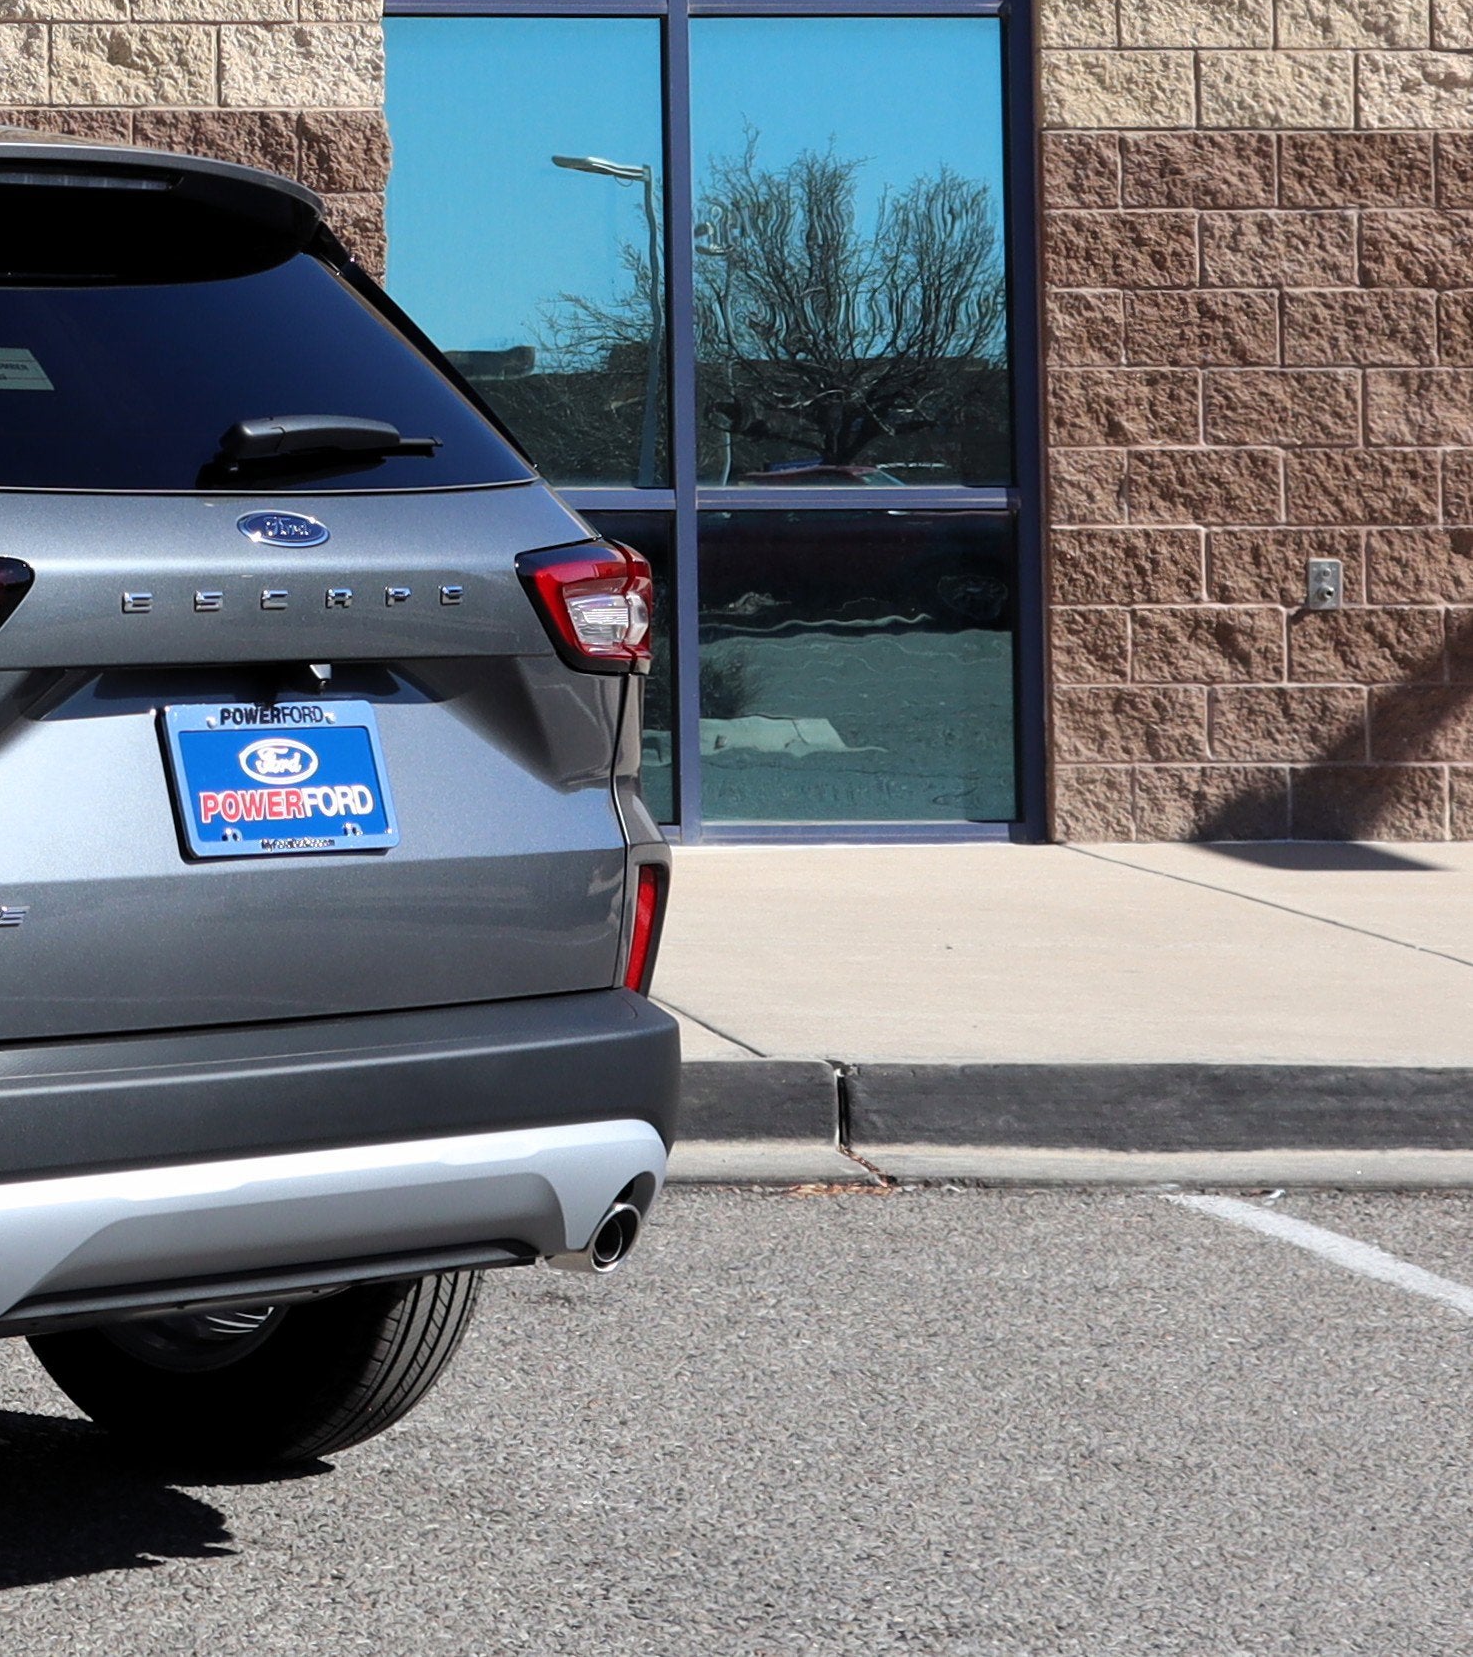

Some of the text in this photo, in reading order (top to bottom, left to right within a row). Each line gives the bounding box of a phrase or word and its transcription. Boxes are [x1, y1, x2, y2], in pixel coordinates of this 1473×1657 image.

[123, 585, 462, 612] ESCAPE
[221, 706, 324, 725] POWERFORD
[255, 746, 302, 774] Ford
[200, 786, 373, 823] POWERFORD
